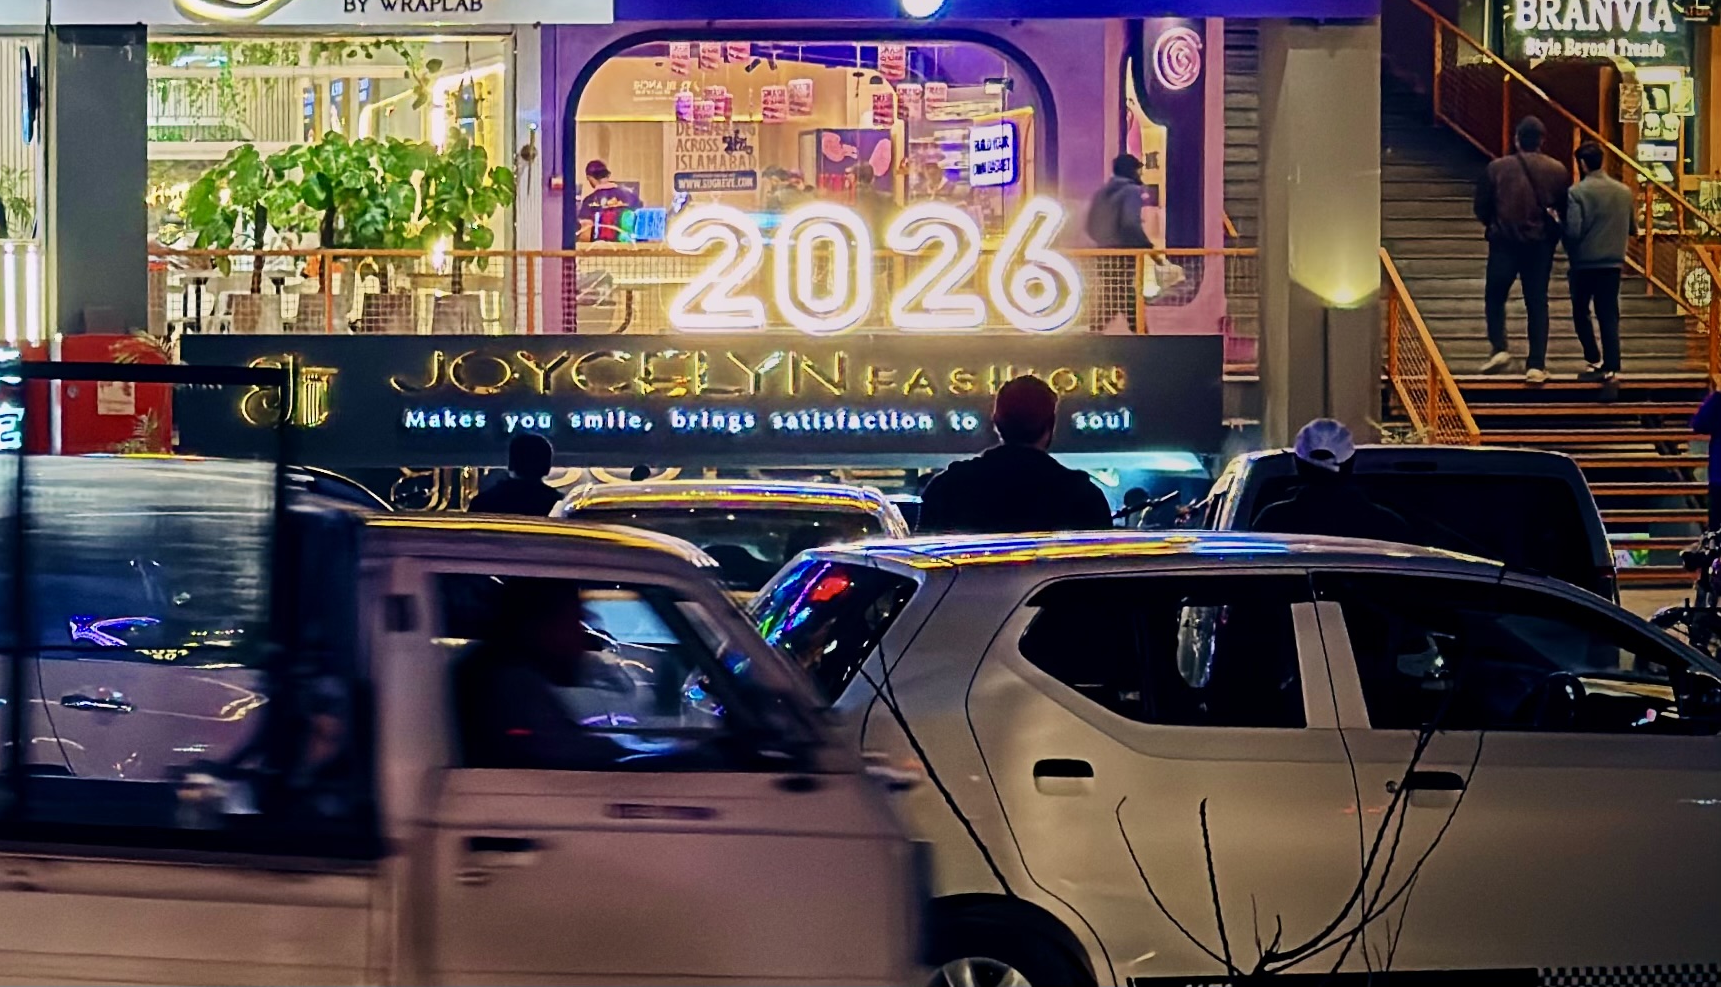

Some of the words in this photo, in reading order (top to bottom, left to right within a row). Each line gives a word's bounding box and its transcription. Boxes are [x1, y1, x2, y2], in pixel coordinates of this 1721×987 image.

[676, 138, 719, 153] ACROSS
[675, 154, 756, 170] ISLAMABAD
[668, 195, 1085, 336] 2026
[866, 364, 1128, 397] FASHON
[405, 411, 487, 429] Makes
[506, 414, 553, 433] you
[570, 410, 654, 433] smile,
[671, 410, 756, 433] brings
[771, 408, 935, 431] satisfaction
[951, 409, 979, 431] to
[1075, 409, 1132, 431] soul
